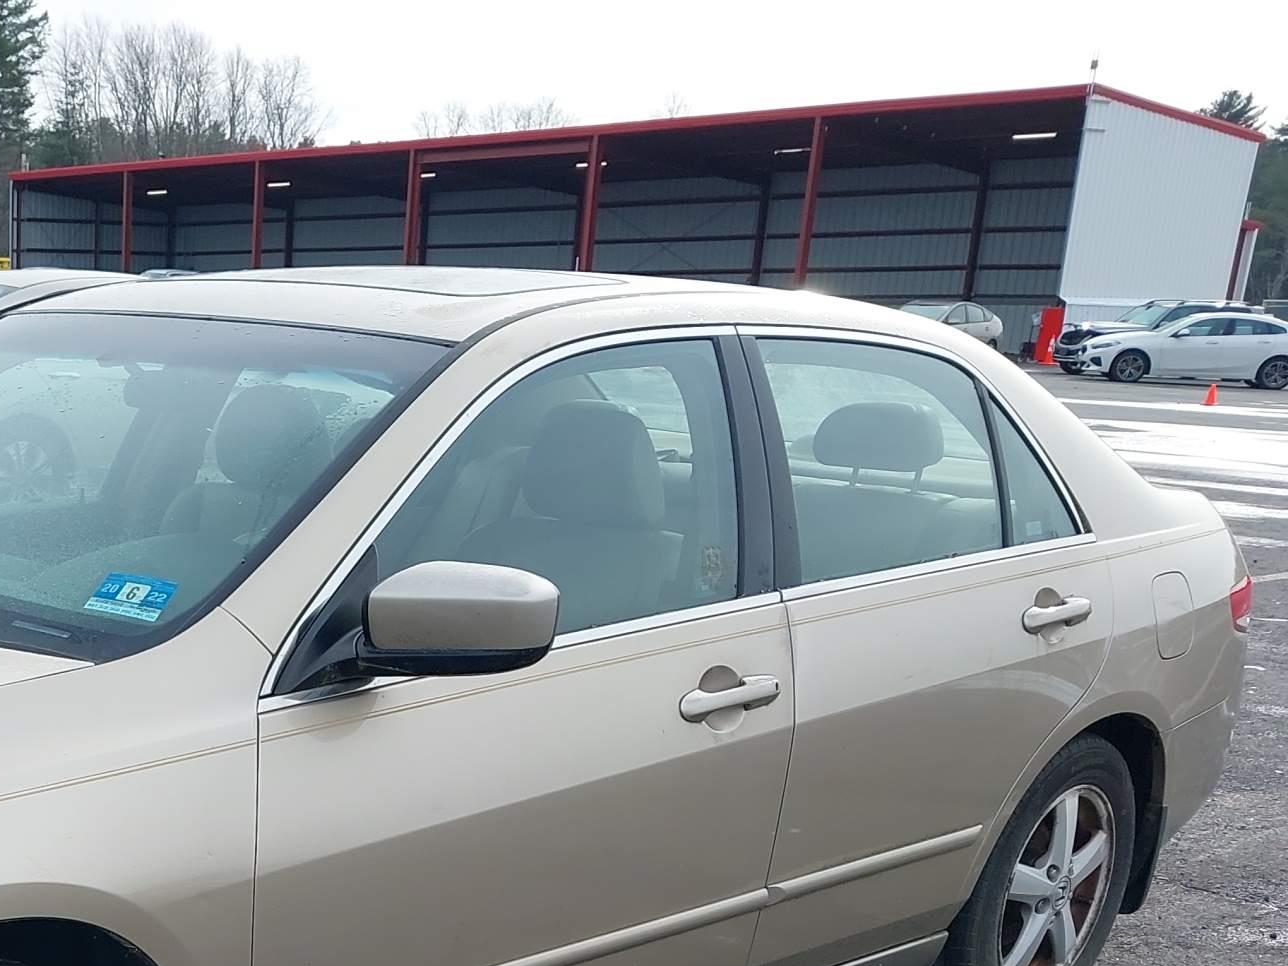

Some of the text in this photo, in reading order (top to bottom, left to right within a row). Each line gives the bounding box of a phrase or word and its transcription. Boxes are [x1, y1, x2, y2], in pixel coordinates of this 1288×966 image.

[101, 583, 167, 601] 20 6 22
